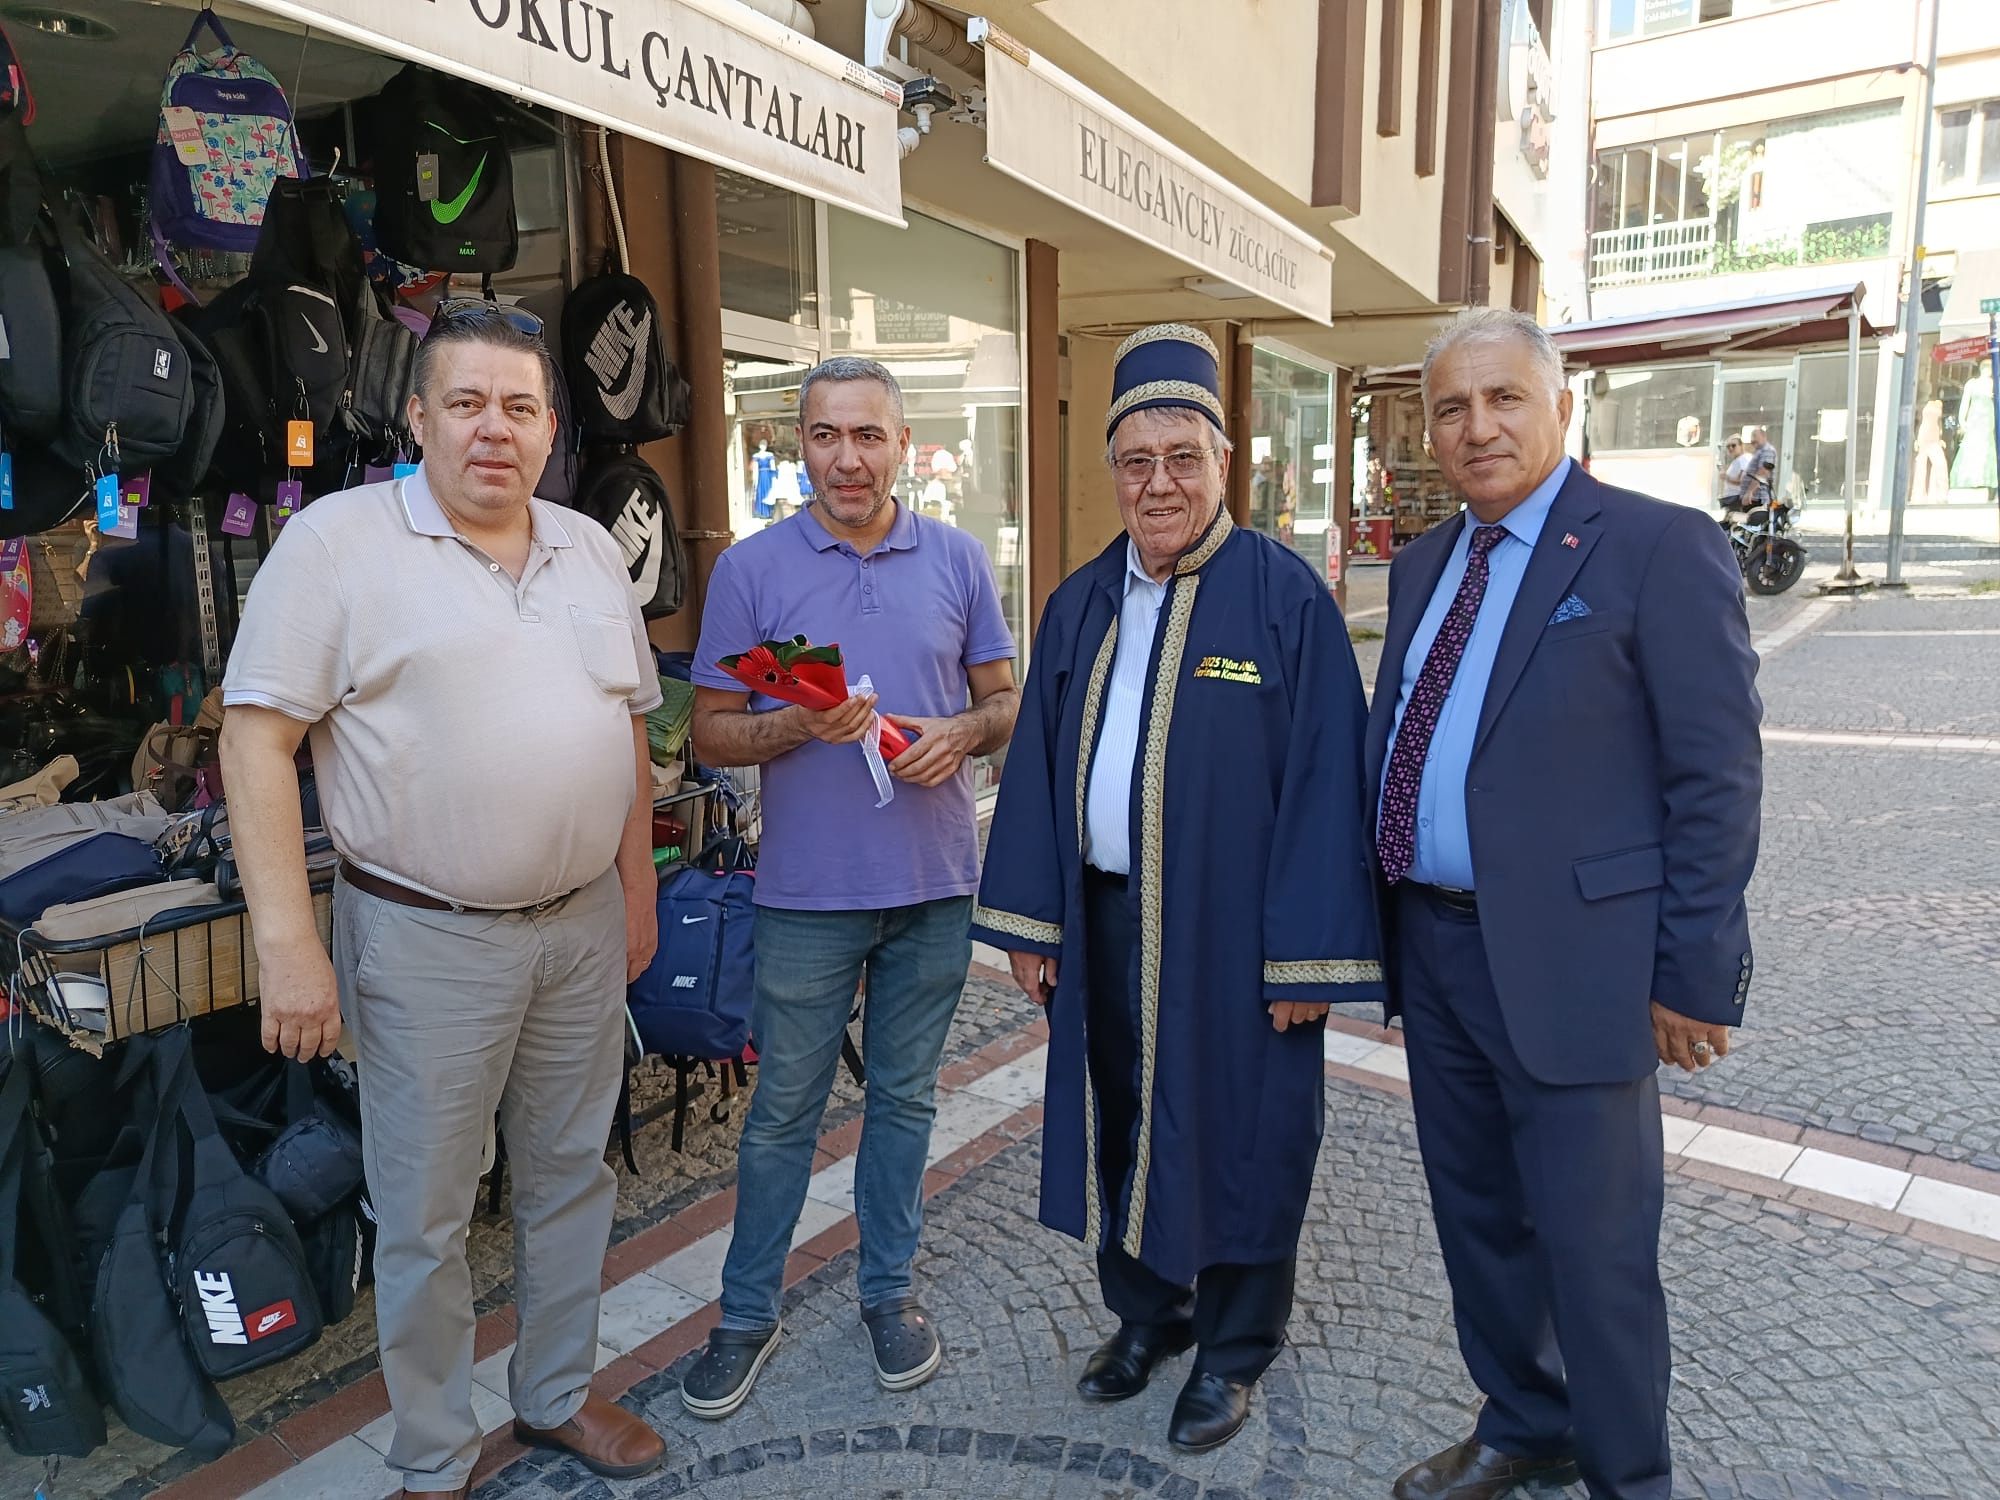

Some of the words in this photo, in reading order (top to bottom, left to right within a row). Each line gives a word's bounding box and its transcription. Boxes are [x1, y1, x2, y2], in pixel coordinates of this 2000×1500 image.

[641, 31, 867, 175] ÇANTALARI
[1078, 122, 1225, 250] ELEGANCEV
[1228, 224, 1298, 290] ZÜCCACİYE
[459, 248, 476, 256] MAX
[584, 299, 644, 391] NIKE
[1200, 656, 1221, 668] 2025
[671, 975, 698, 988] NIKE
[193, 1270, 248, 1345] NIKE
[261, 1310, 281, 1324] NIKE
